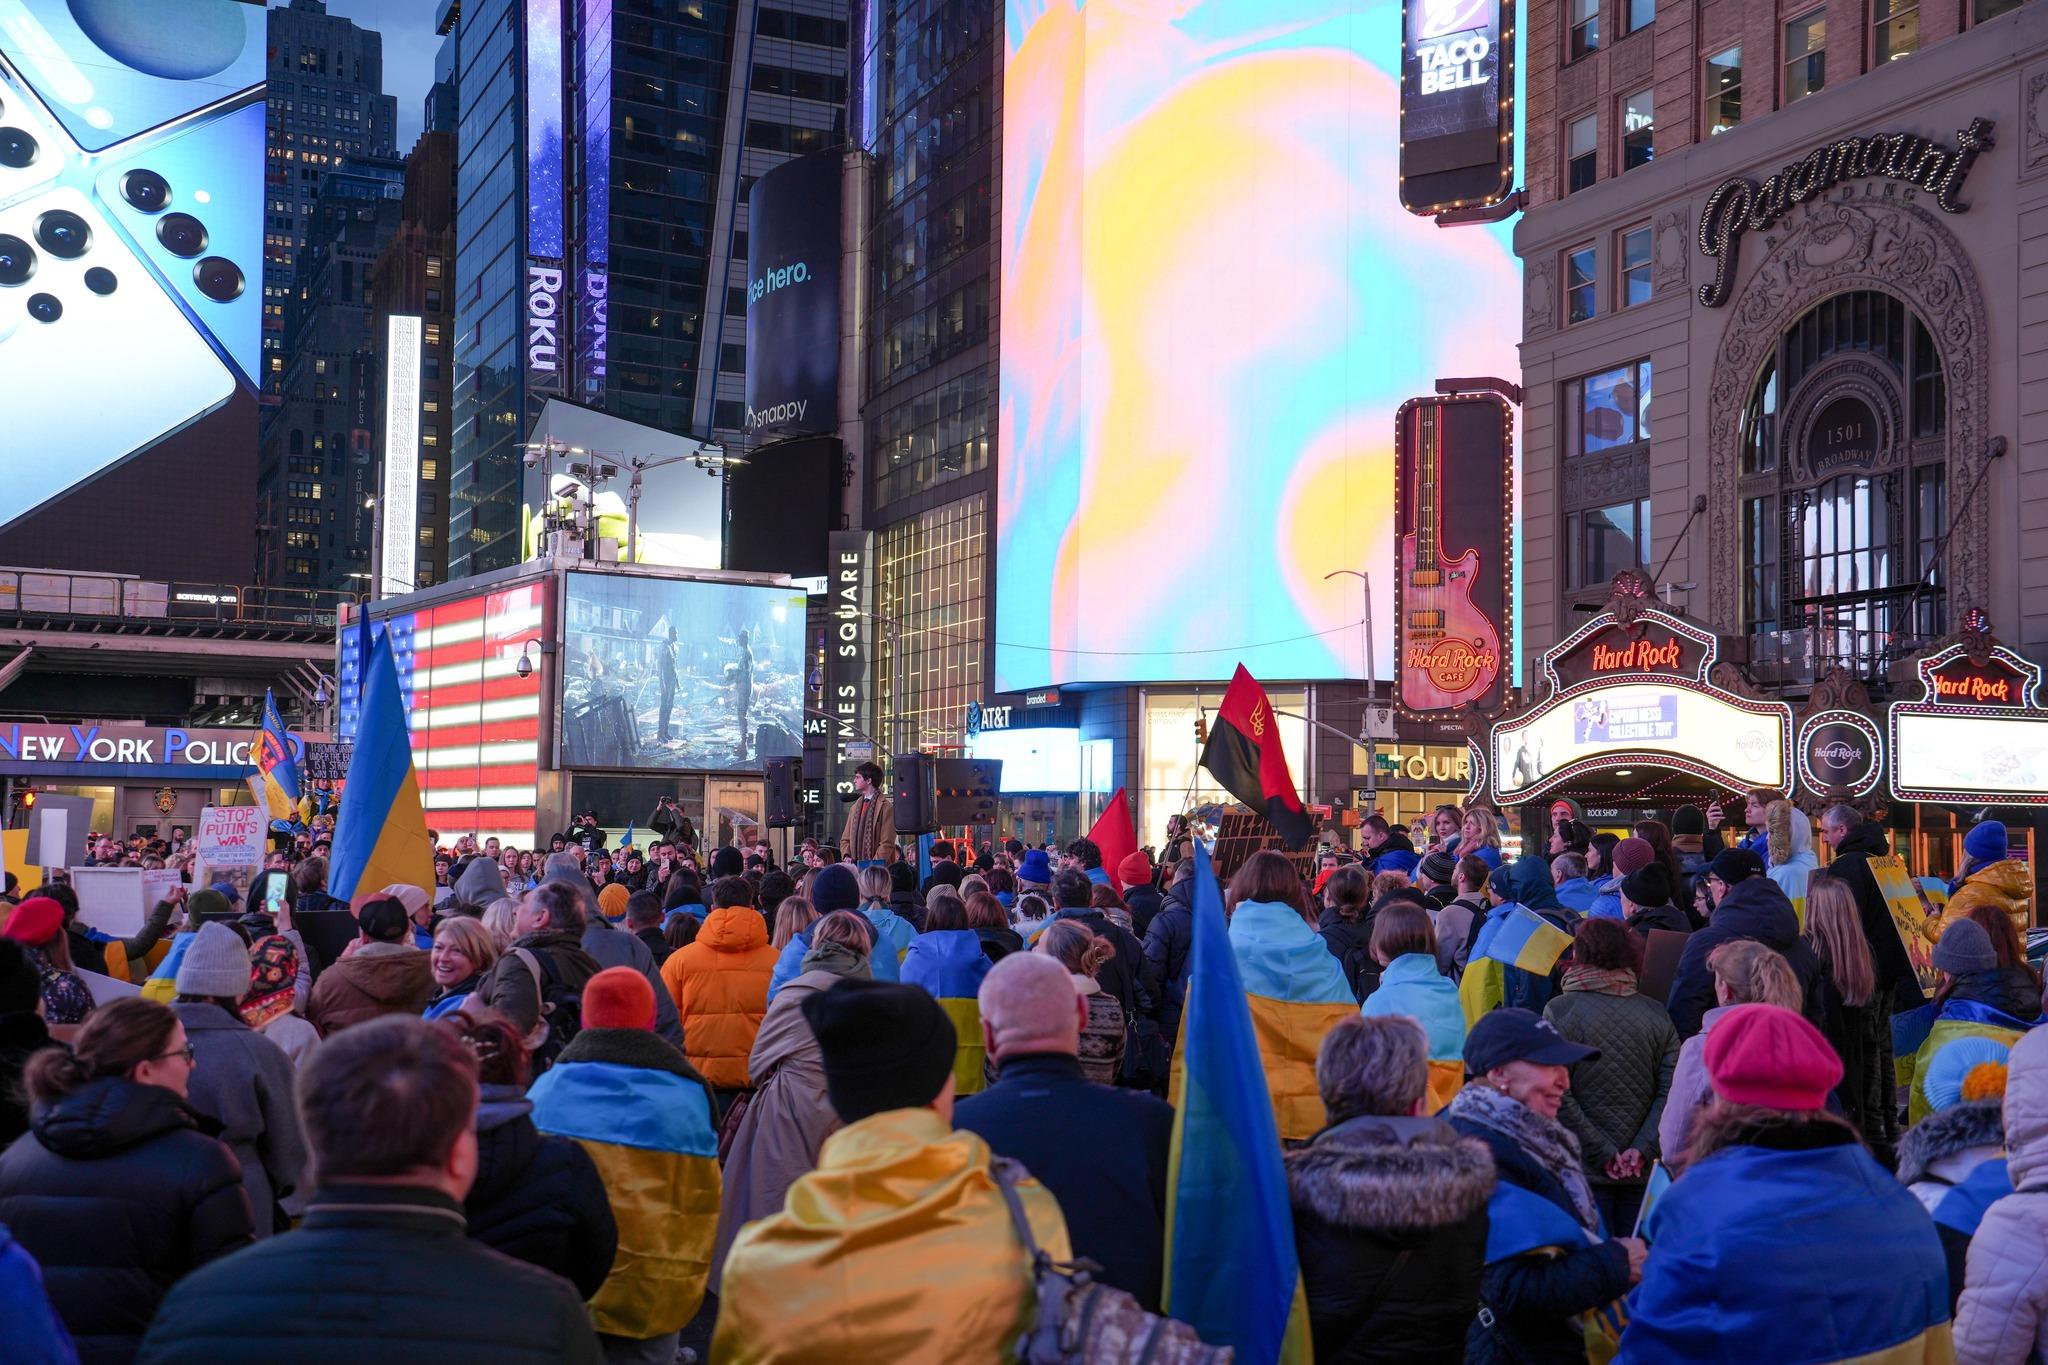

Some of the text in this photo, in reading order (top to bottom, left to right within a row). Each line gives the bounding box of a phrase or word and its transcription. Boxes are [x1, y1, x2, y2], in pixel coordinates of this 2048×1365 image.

[1416, 36, 1489, 72] TACO
[1421, 61, 1491, 96] BELL
[1699, 117, 1996, 307] Paramount
[766, 261, 812, 294] hero.
[757, 400, 807, 428] snappy
[1828, 423, 1862, 445] 1501
[1817, 449, 1872, 470] BROADWAY
[176, 592, 237, 604] samsung.om
[839, 553, 858, 657] SQUARE
[1407, 648, 1495, 672] Hard Rock
[1592, 637, 1680, 672] Hard Rock
[1439, 673, 1464, 682] CAFE
[1934, 675, 2008, 702] Hard Rock
[980, 706, 1012, 730] AT&T
[70, 726, 153, 763] YORK
[164, 729, 258, 765] POLIC
[1814, 747, 1862, 759] Hard Rock
[836, 781, 854, 794] 3
[215, 808, 254, 823] STOP
[1587, 809, 1618, 817] ROCK SHOP
[206, 821, 258, 836] PUTIN'S
[217, 835, 247, 846] WAR
